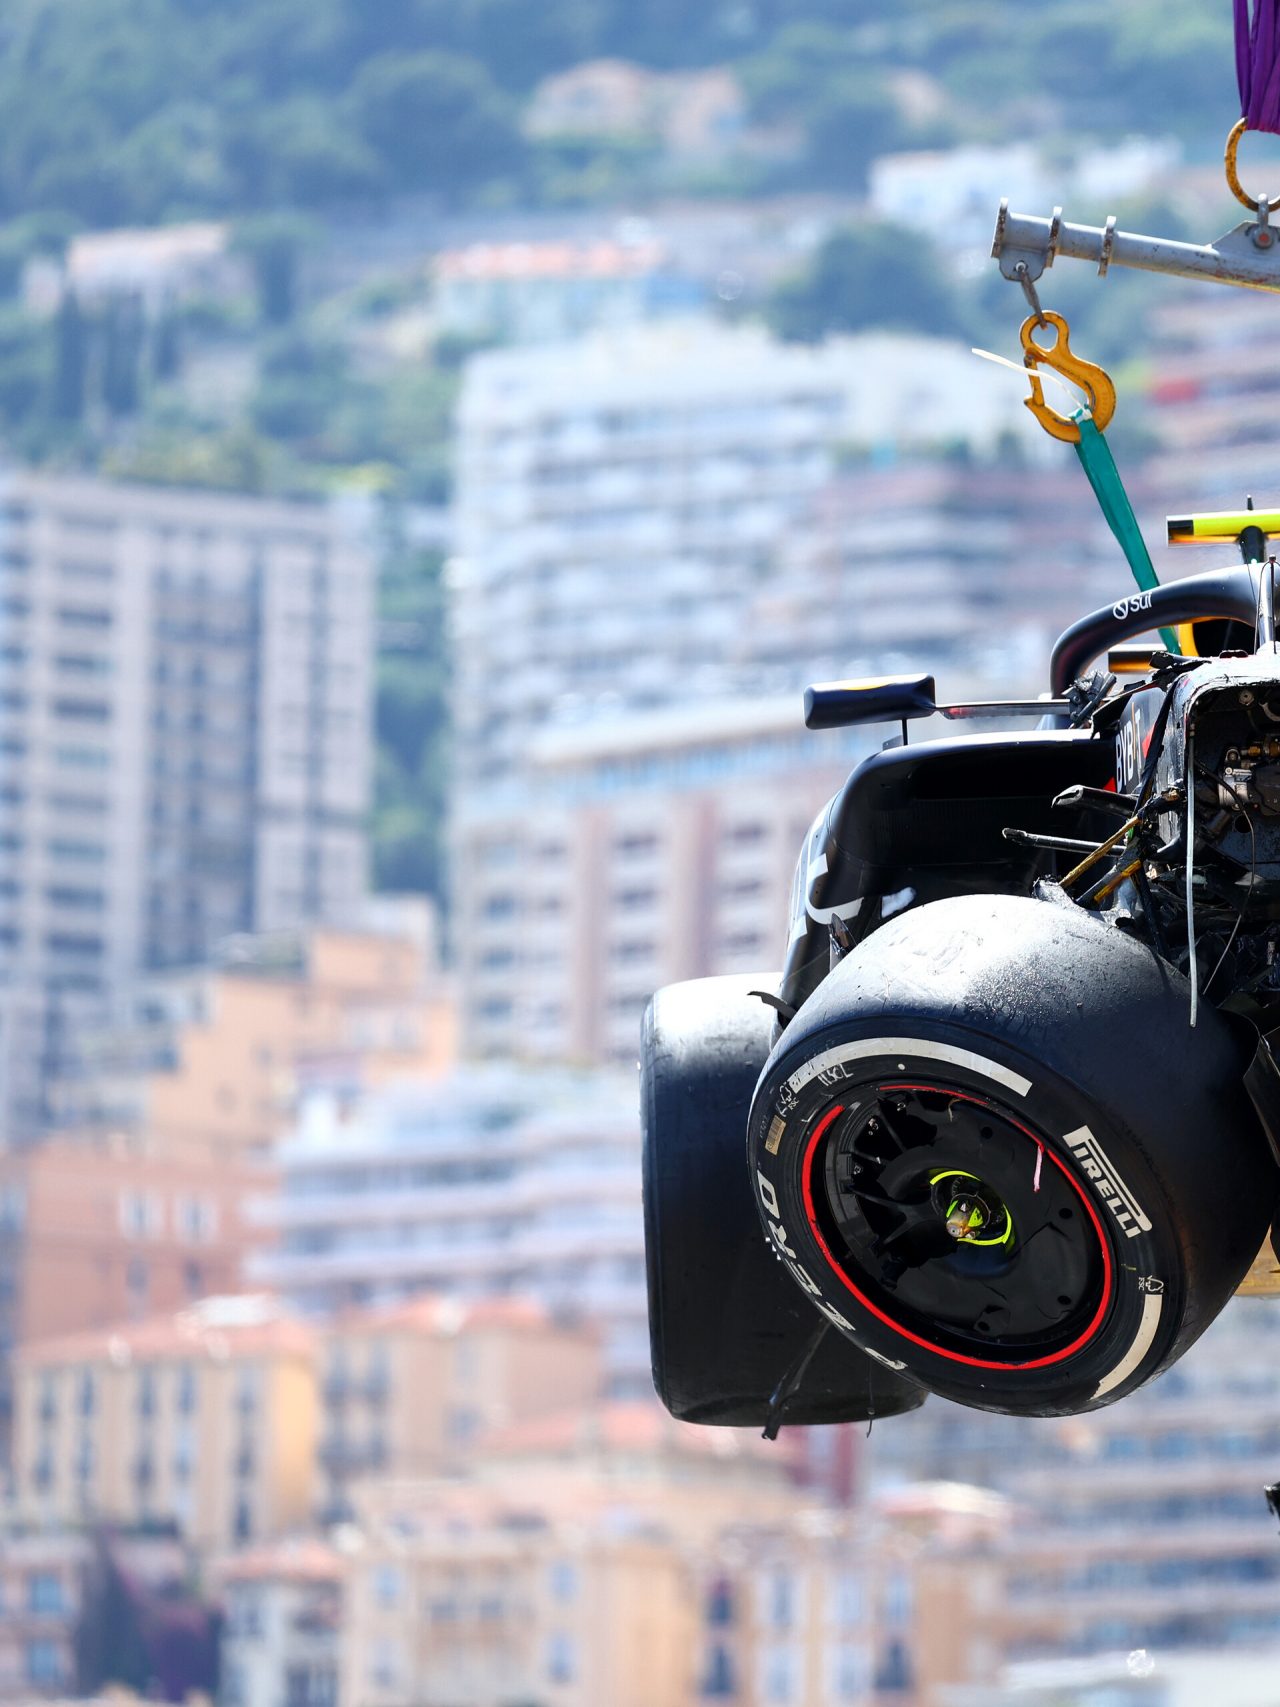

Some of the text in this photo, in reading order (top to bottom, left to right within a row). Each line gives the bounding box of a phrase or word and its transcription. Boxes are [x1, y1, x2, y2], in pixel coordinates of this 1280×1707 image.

[1130, 591, 1153, 612] Sui
[1062, 1124, 1153, 1239] PIRELLI
[757, 1169, 856, 1331] ZERO
